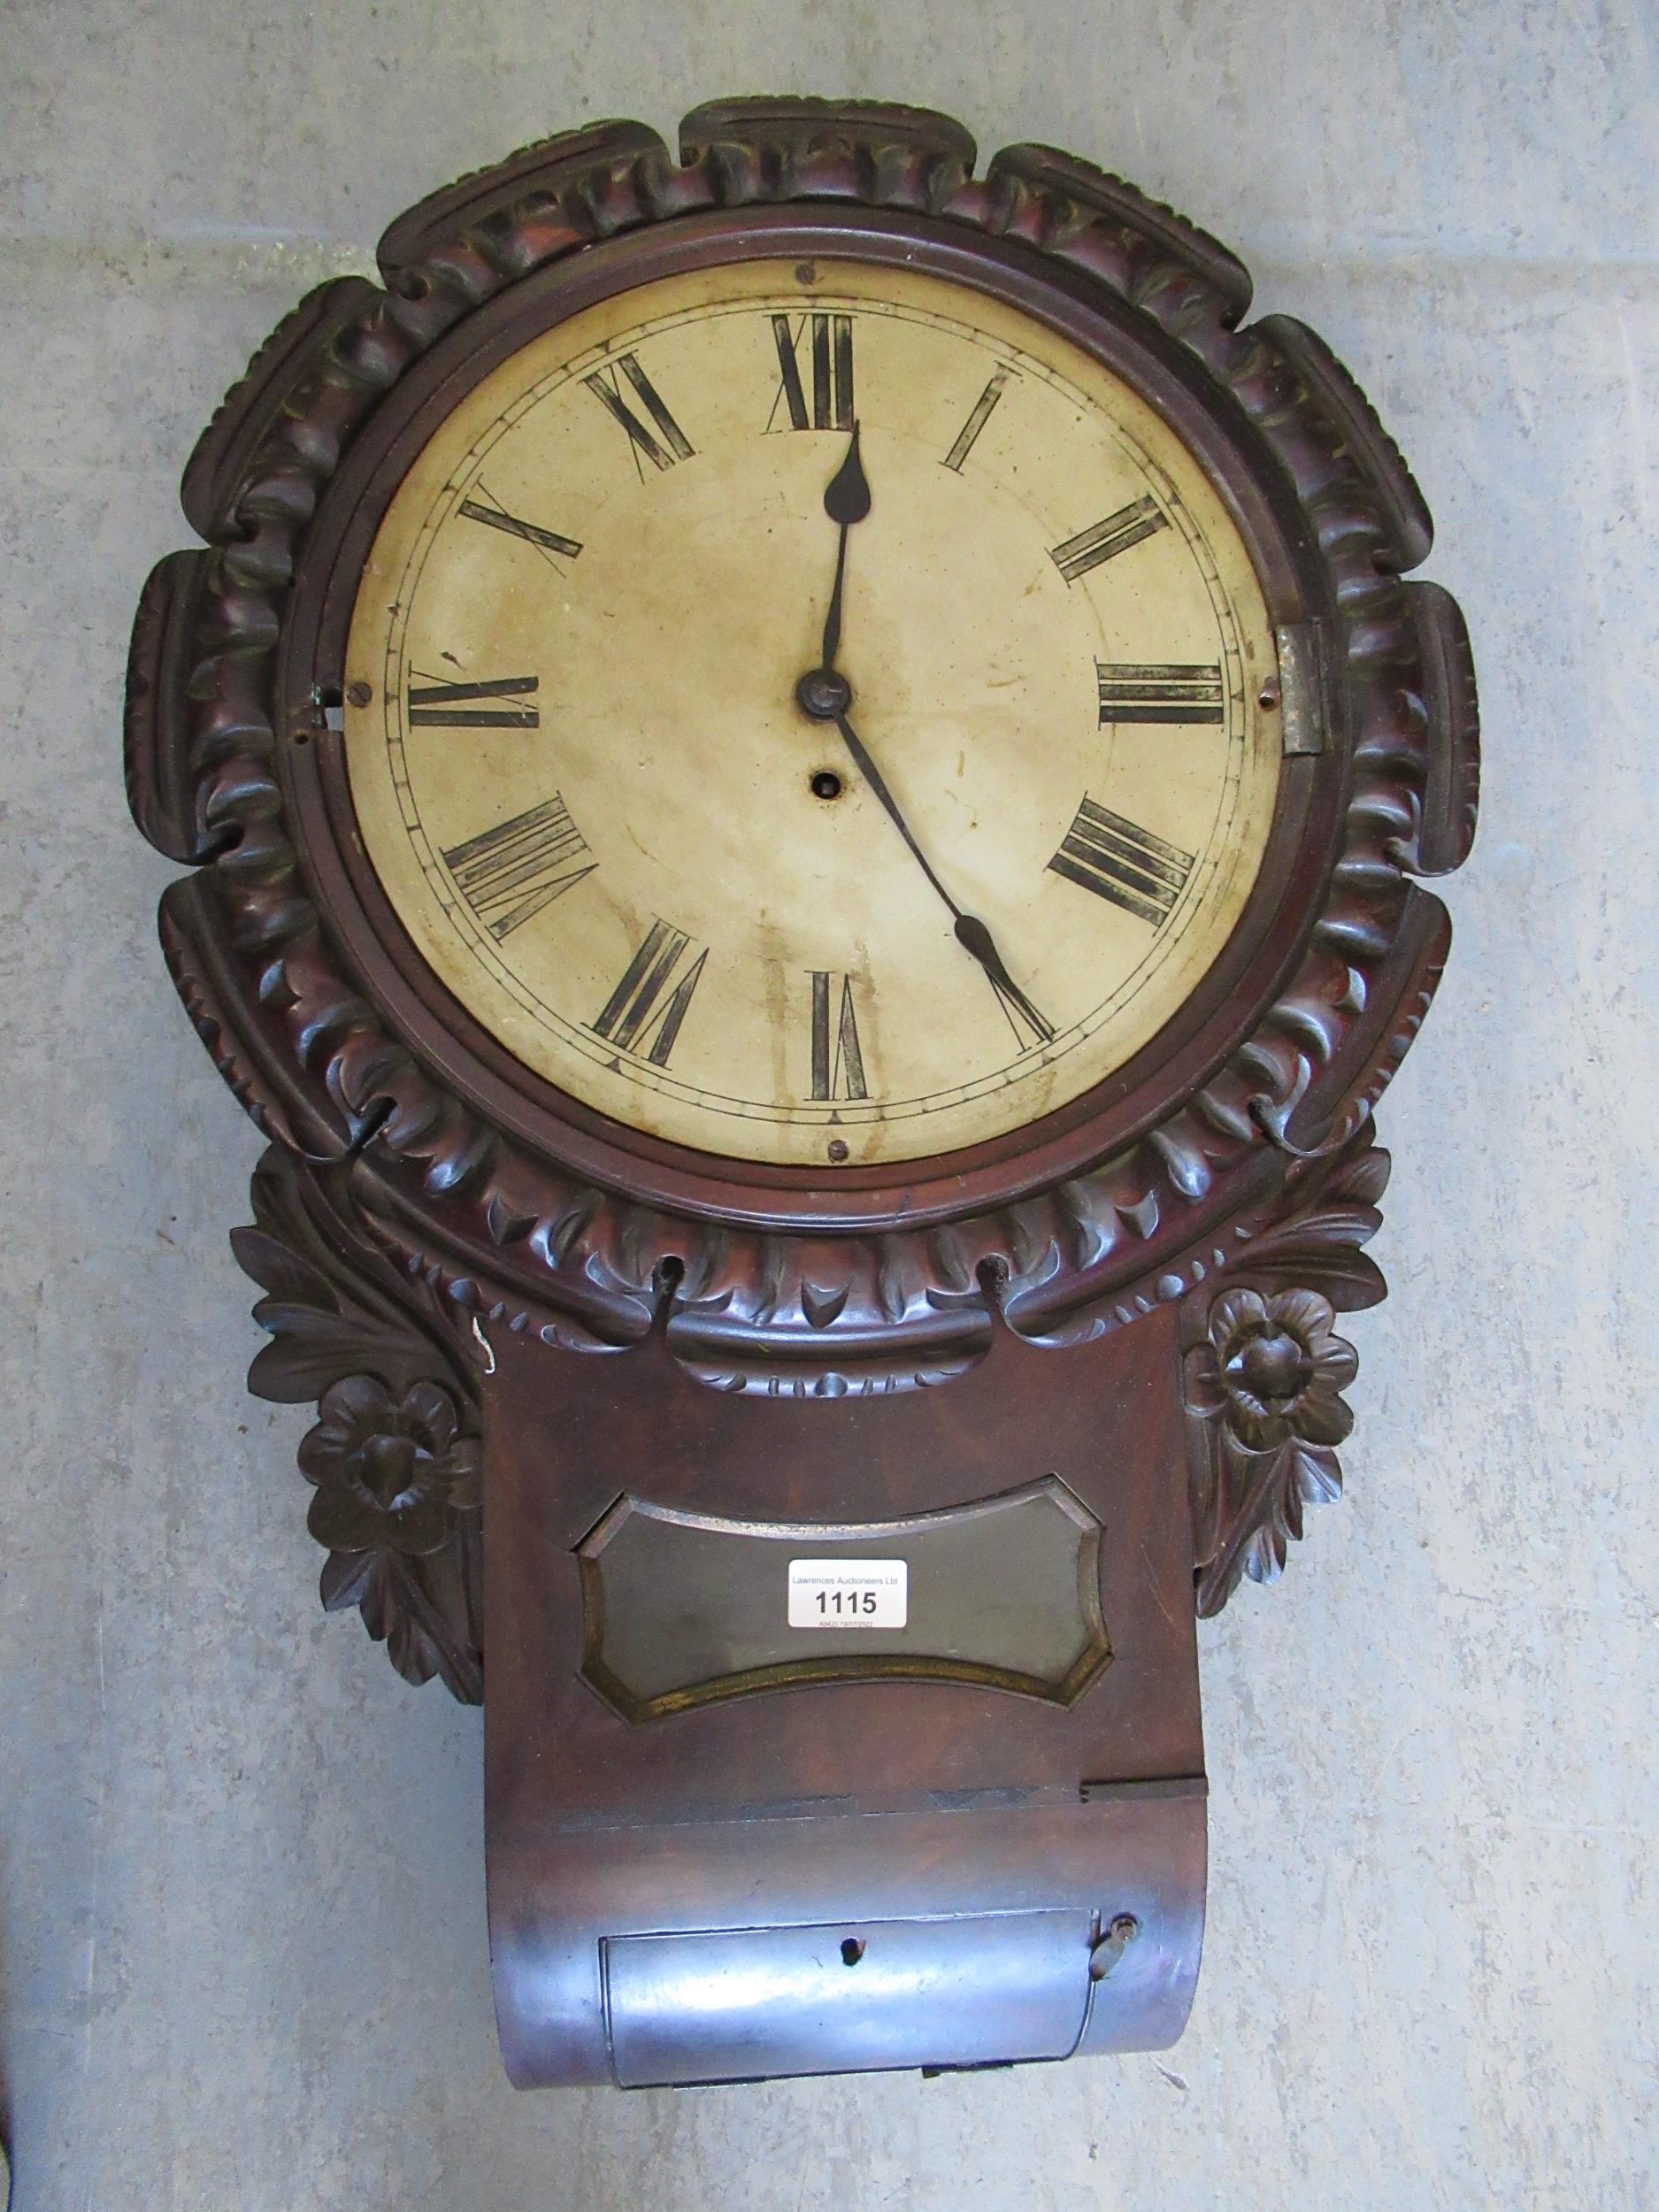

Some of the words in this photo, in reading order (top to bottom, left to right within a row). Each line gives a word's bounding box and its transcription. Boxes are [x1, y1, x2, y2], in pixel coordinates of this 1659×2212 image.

[579, 350, 697, 485] XI
[762, 312, 859, 434] XII
[940, 359, 1022, 474] I
[455, 474, 584, 578] X
[1046, 493, 1172, 588] II
[1094, 656, 1225, 732] III
[438, 791, 600, 946] VIII
[1044, 791, 1200, 936] IIII
[581, 914, 710, 1071] VII
[803, 971, 878, 1102] VI
[816, 1591, 877, 1614] 1115
